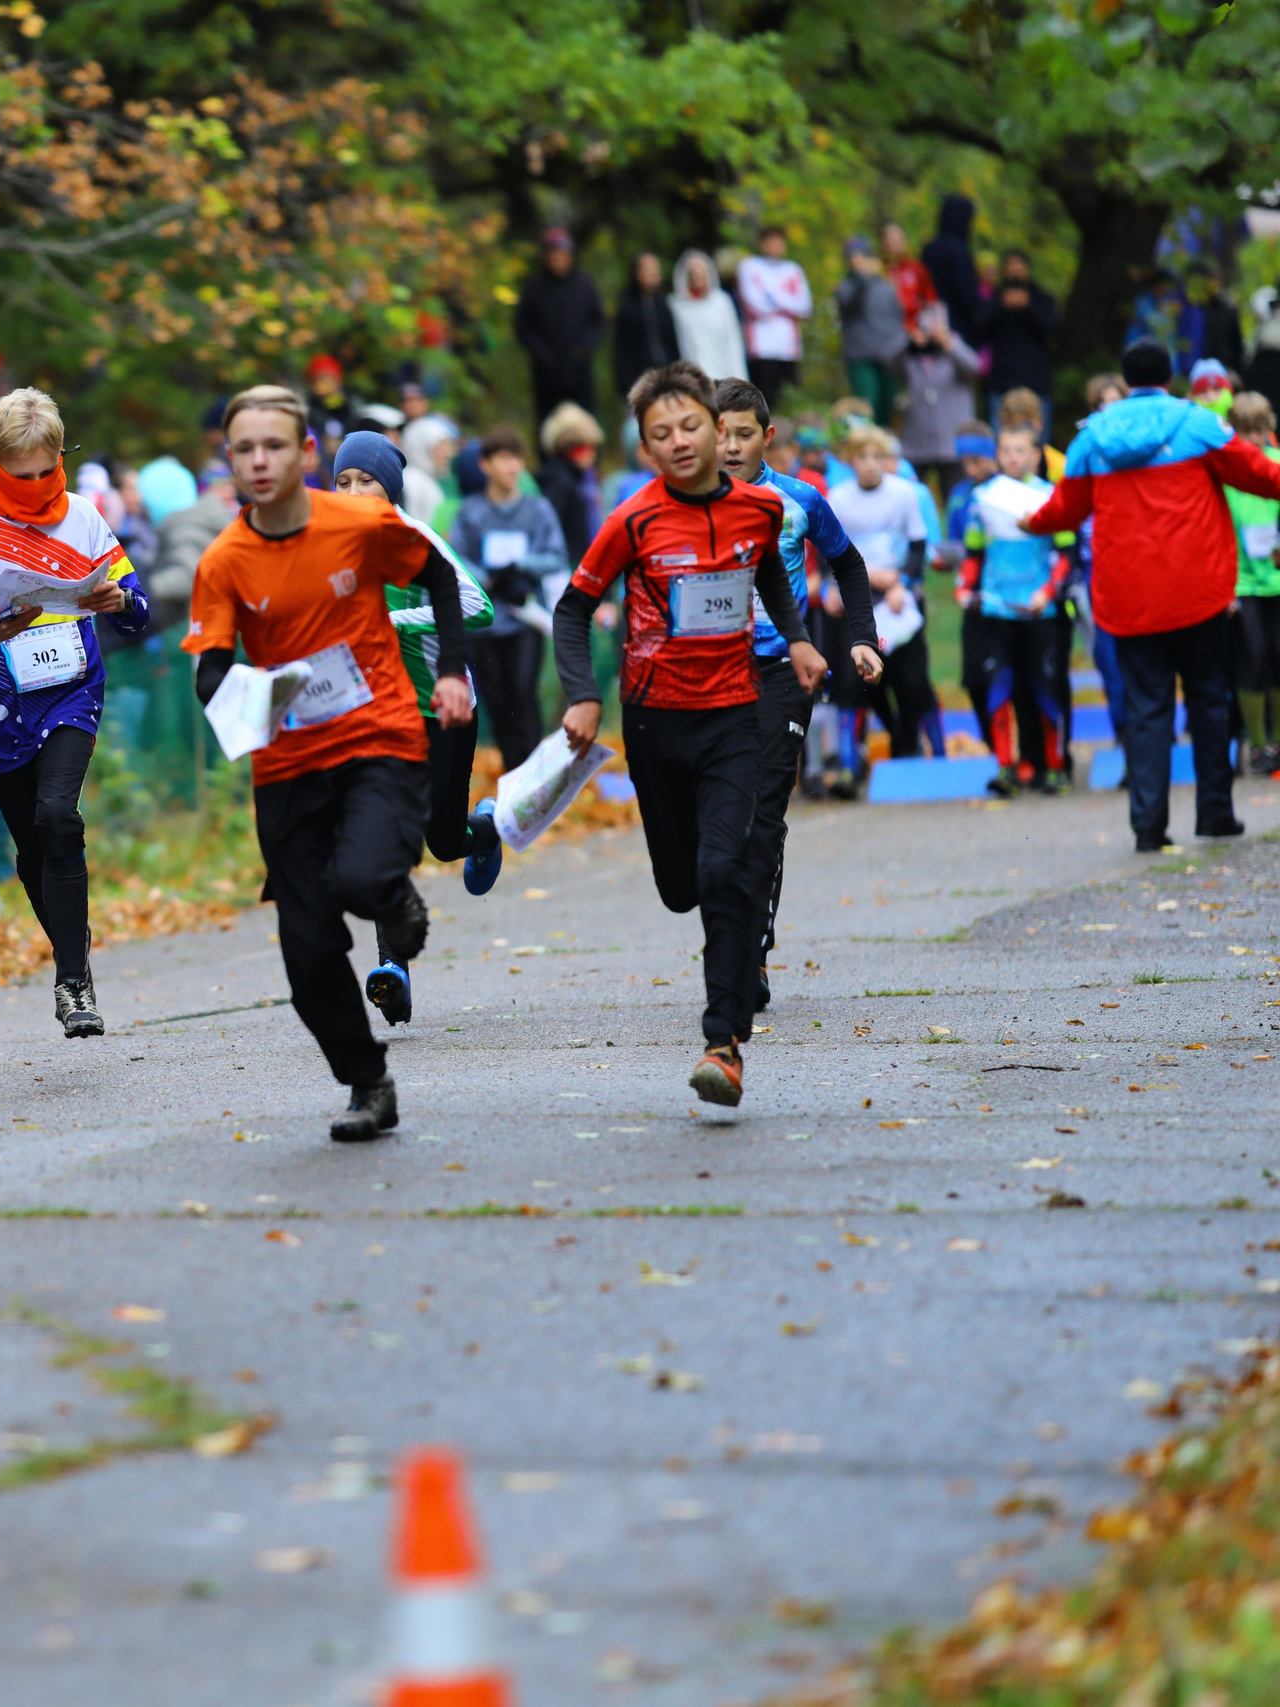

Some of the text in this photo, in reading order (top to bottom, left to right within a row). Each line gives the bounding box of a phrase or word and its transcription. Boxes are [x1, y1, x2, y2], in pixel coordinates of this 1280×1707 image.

[328, 568, 357, 599] 10
[703, 596, 733, 614] 298
[32, 648, 59, 667] 302
